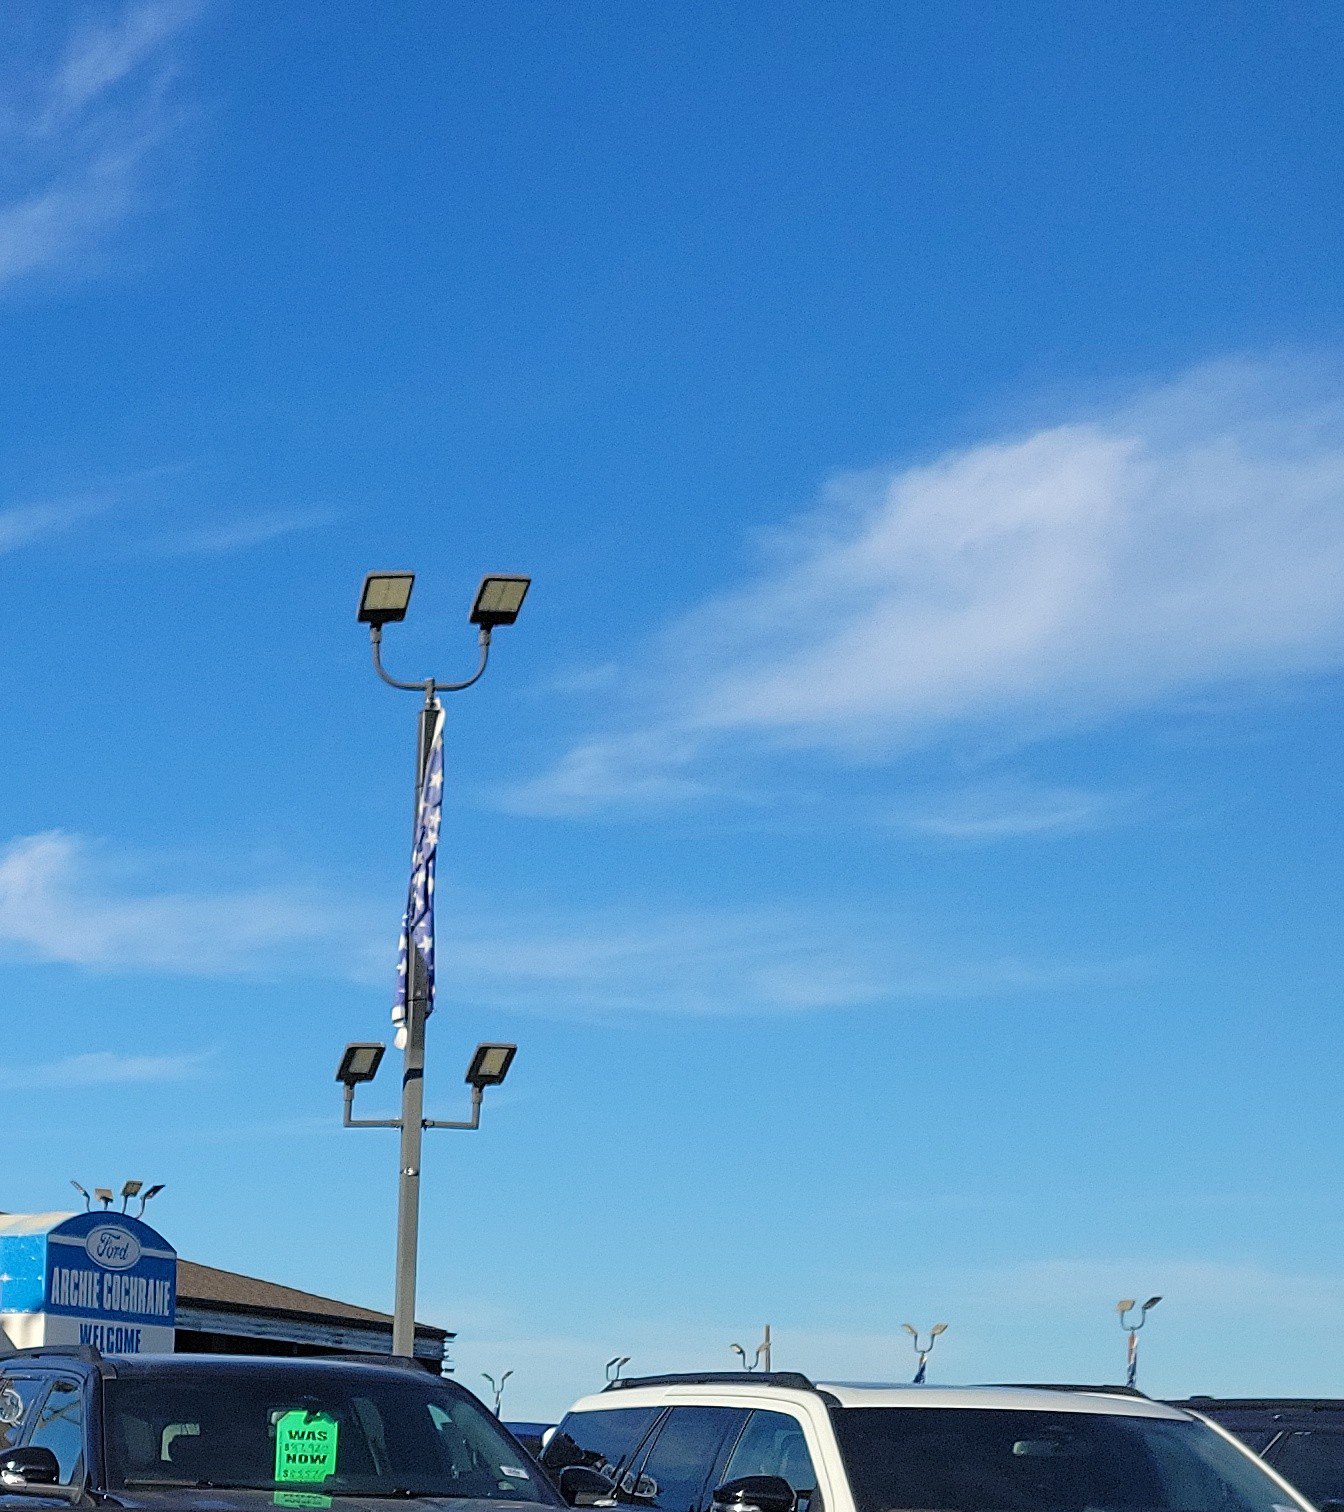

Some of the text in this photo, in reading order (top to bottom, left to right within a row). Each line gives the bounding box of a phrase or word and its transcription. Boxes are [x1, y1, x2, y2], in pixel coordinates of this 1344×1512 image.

[96, 1232, 130, 1260] Ford
[51, 1267, 171, 1317] ARCHIE COCHRANE
[79, 1323, 142, 1354] WELCOME
[288, 1429, 328, 1441] WAS
[285, 1453, 328, 1465] NOW
